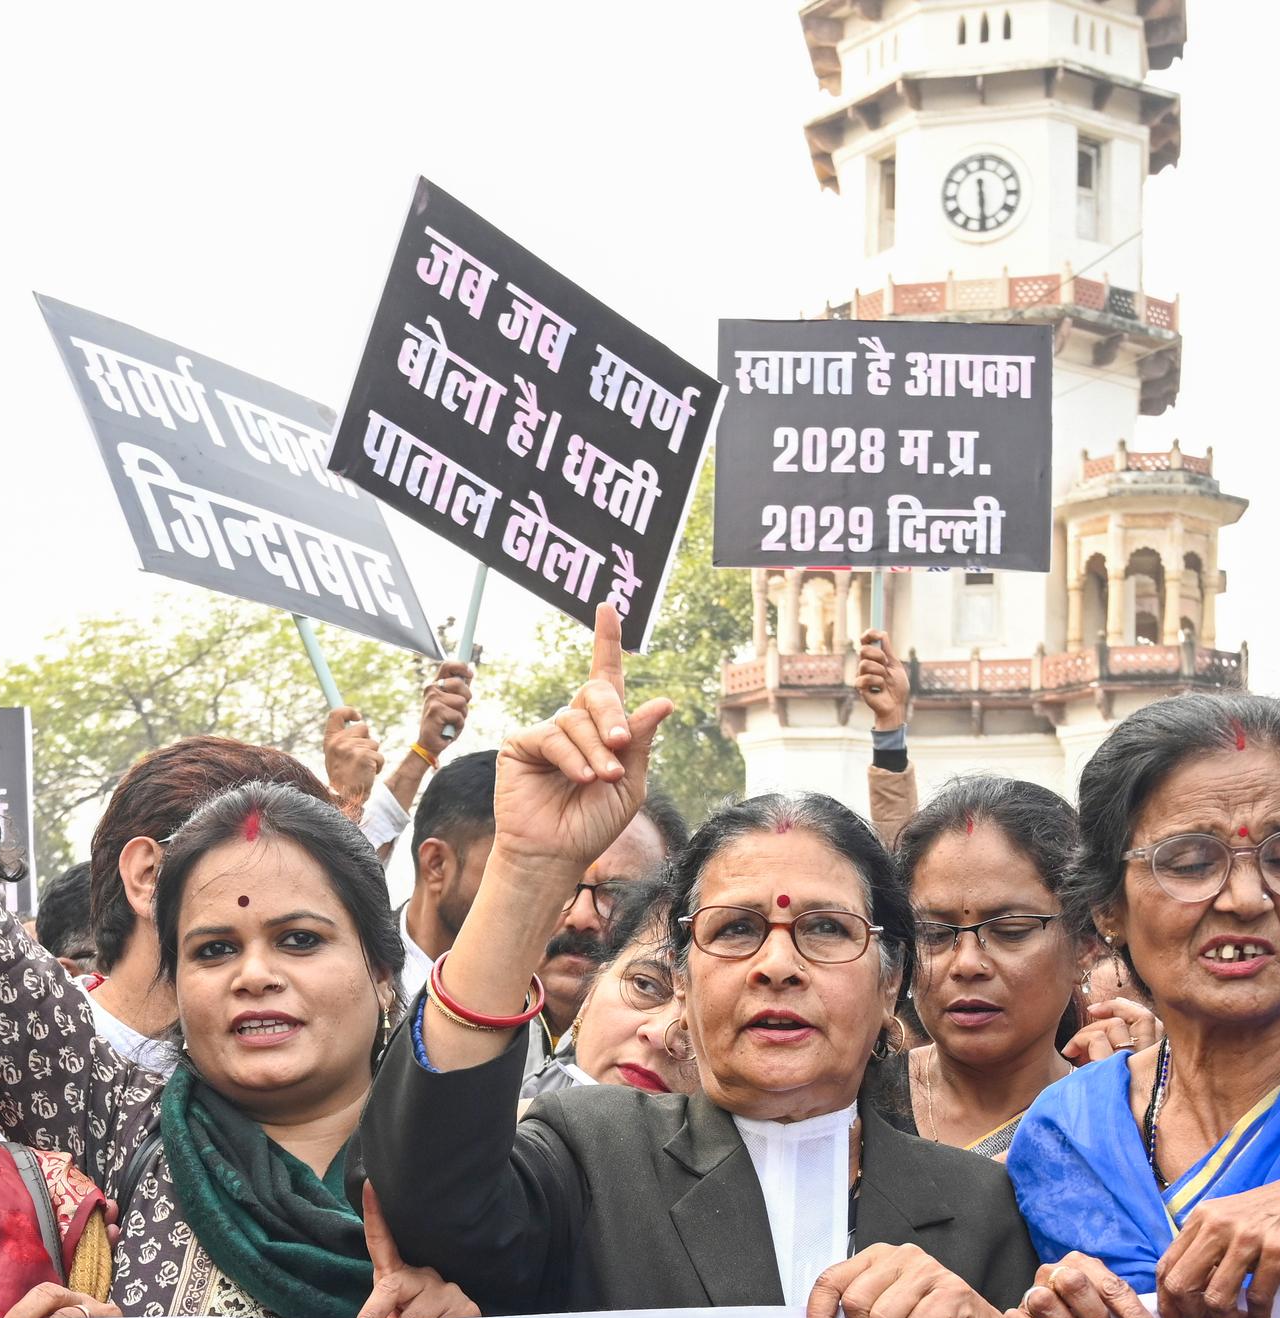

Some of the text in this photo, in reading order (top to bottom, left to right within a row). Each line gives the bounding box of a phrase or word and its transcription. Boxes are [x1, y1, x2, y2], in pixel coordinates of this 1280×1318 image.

[69, 335, 227, 448] सवर्ण
[416, 226, 701, 454] जब जब सवर्ण
[734, 336, 1036, 399] स्वागत है आपका
[397, 315, 508, 435] बोला
[561, 434, 663, 536] धरती
[772, 426, 992, 478] 2028 म.प्र.
[117, 442, 414, 629] जिन्दाबाद
[363, 410, 503, 539] पाताल
[606, 543, 644, 622] है
[760, 494, 1007, 555] 2029 दिल्ली
